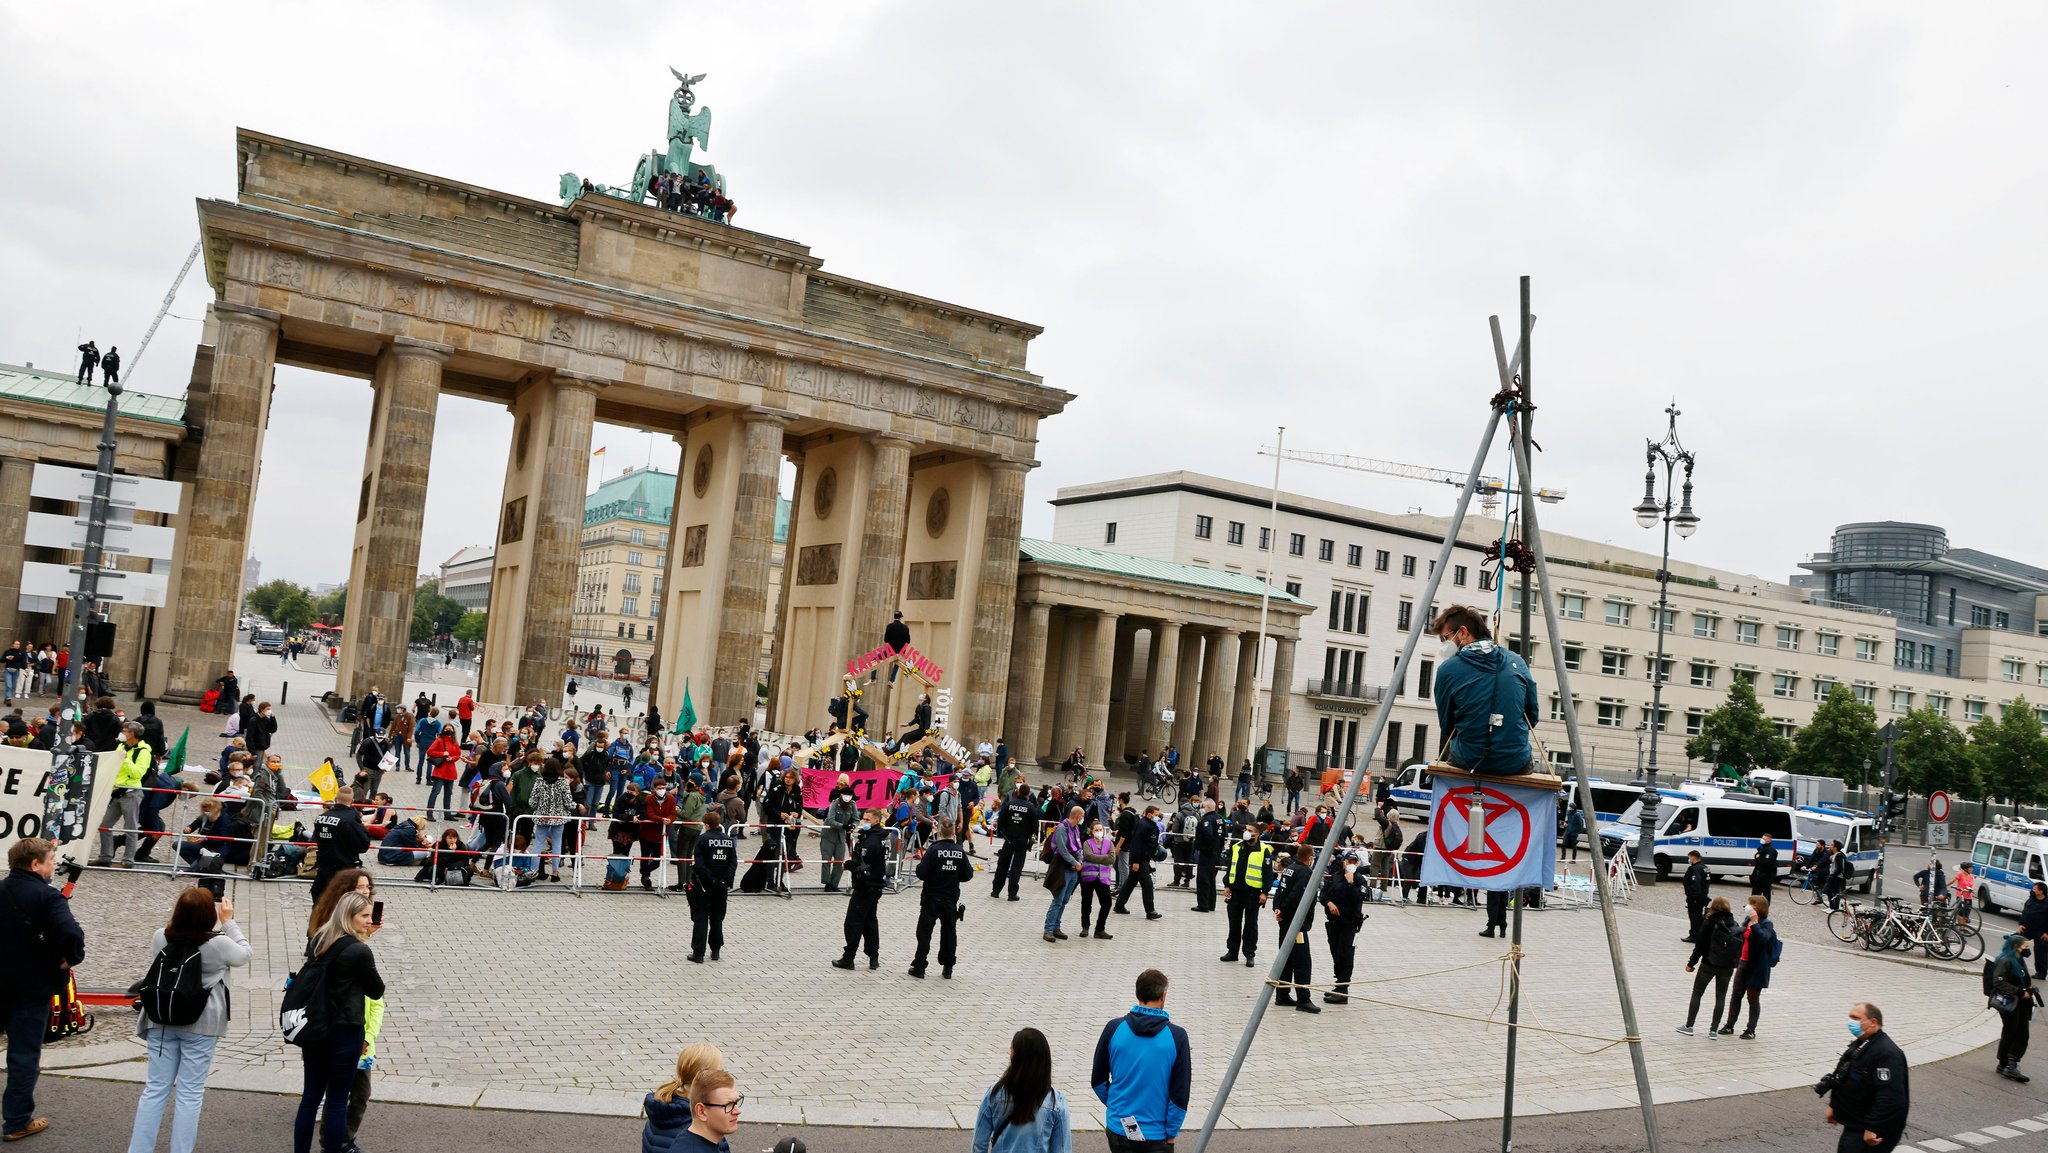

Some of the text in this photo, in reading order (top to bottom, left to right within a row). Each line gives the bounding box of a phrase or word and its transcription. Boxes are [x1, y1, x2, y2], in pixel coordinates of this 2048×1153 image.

[940, 735, 971, 765] UNS!
[315, 815, 341, 826] POLIZEI
[708, 839, 733, 848] POLIZEI
[1713, 838, 1737, 846] POLIZEI
[937, 849, 963, 859] POLIZEI
